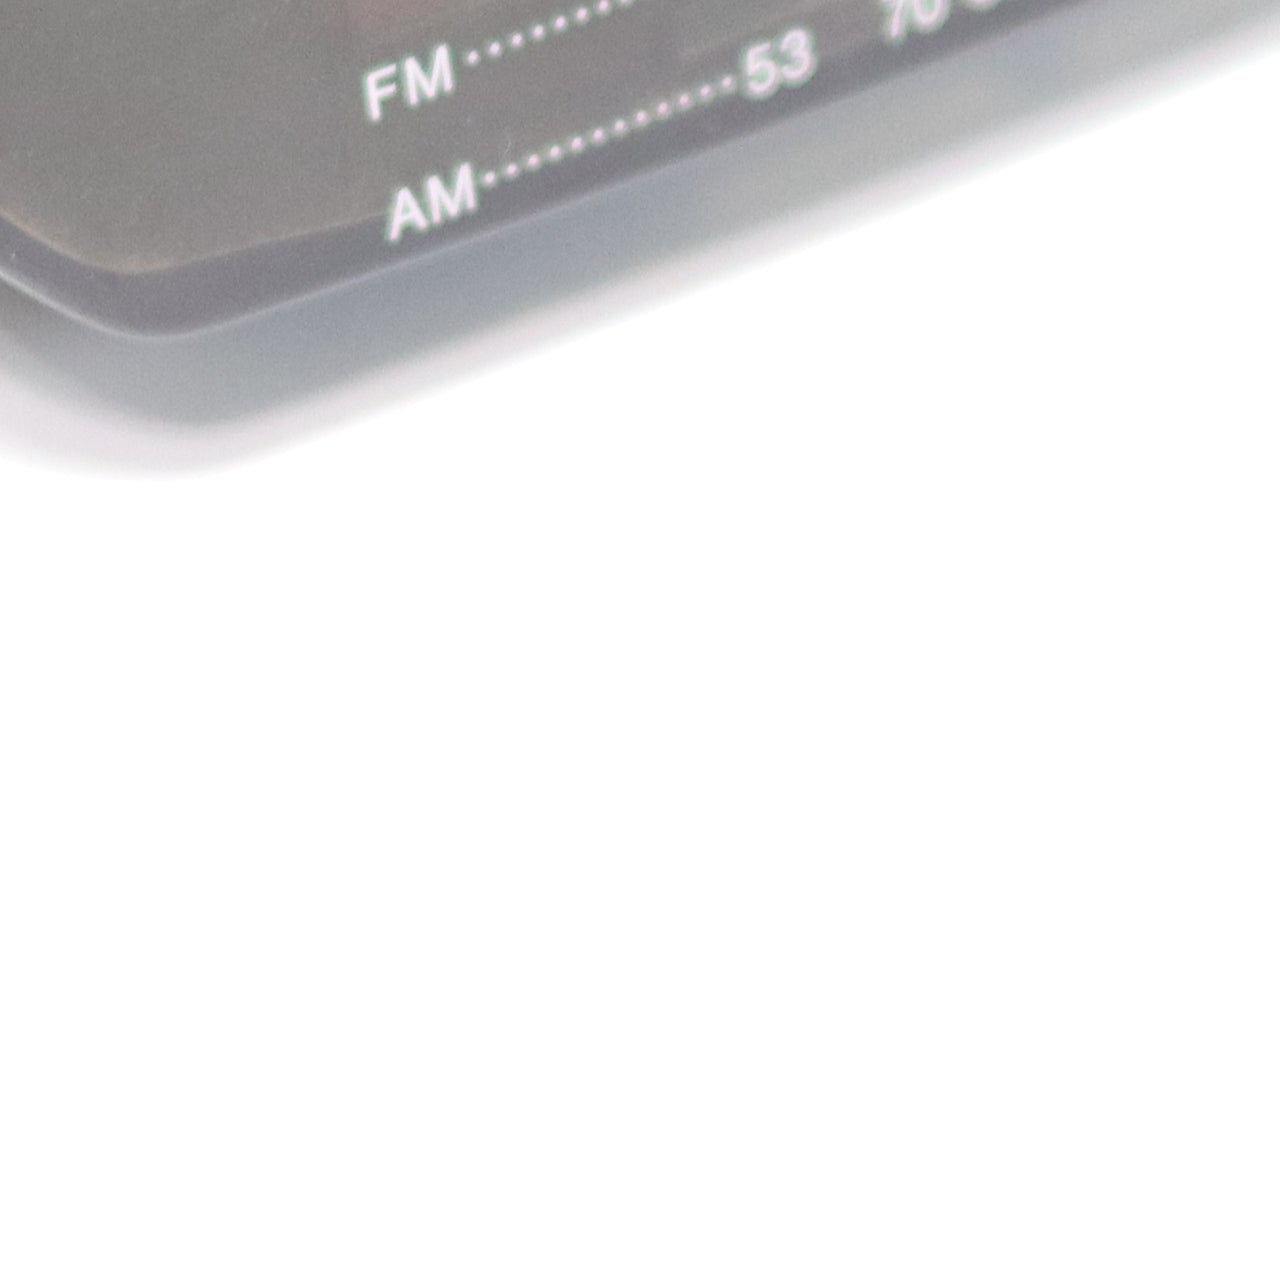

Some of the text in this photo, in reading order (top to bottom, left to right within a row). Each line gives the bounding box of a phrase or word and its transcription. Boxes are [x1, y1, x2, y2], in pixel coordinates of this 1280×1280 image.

[362, 43, 455, 122] FM
[385, 162, 479, 241] AM
[738, 25, 818, 99] 53
